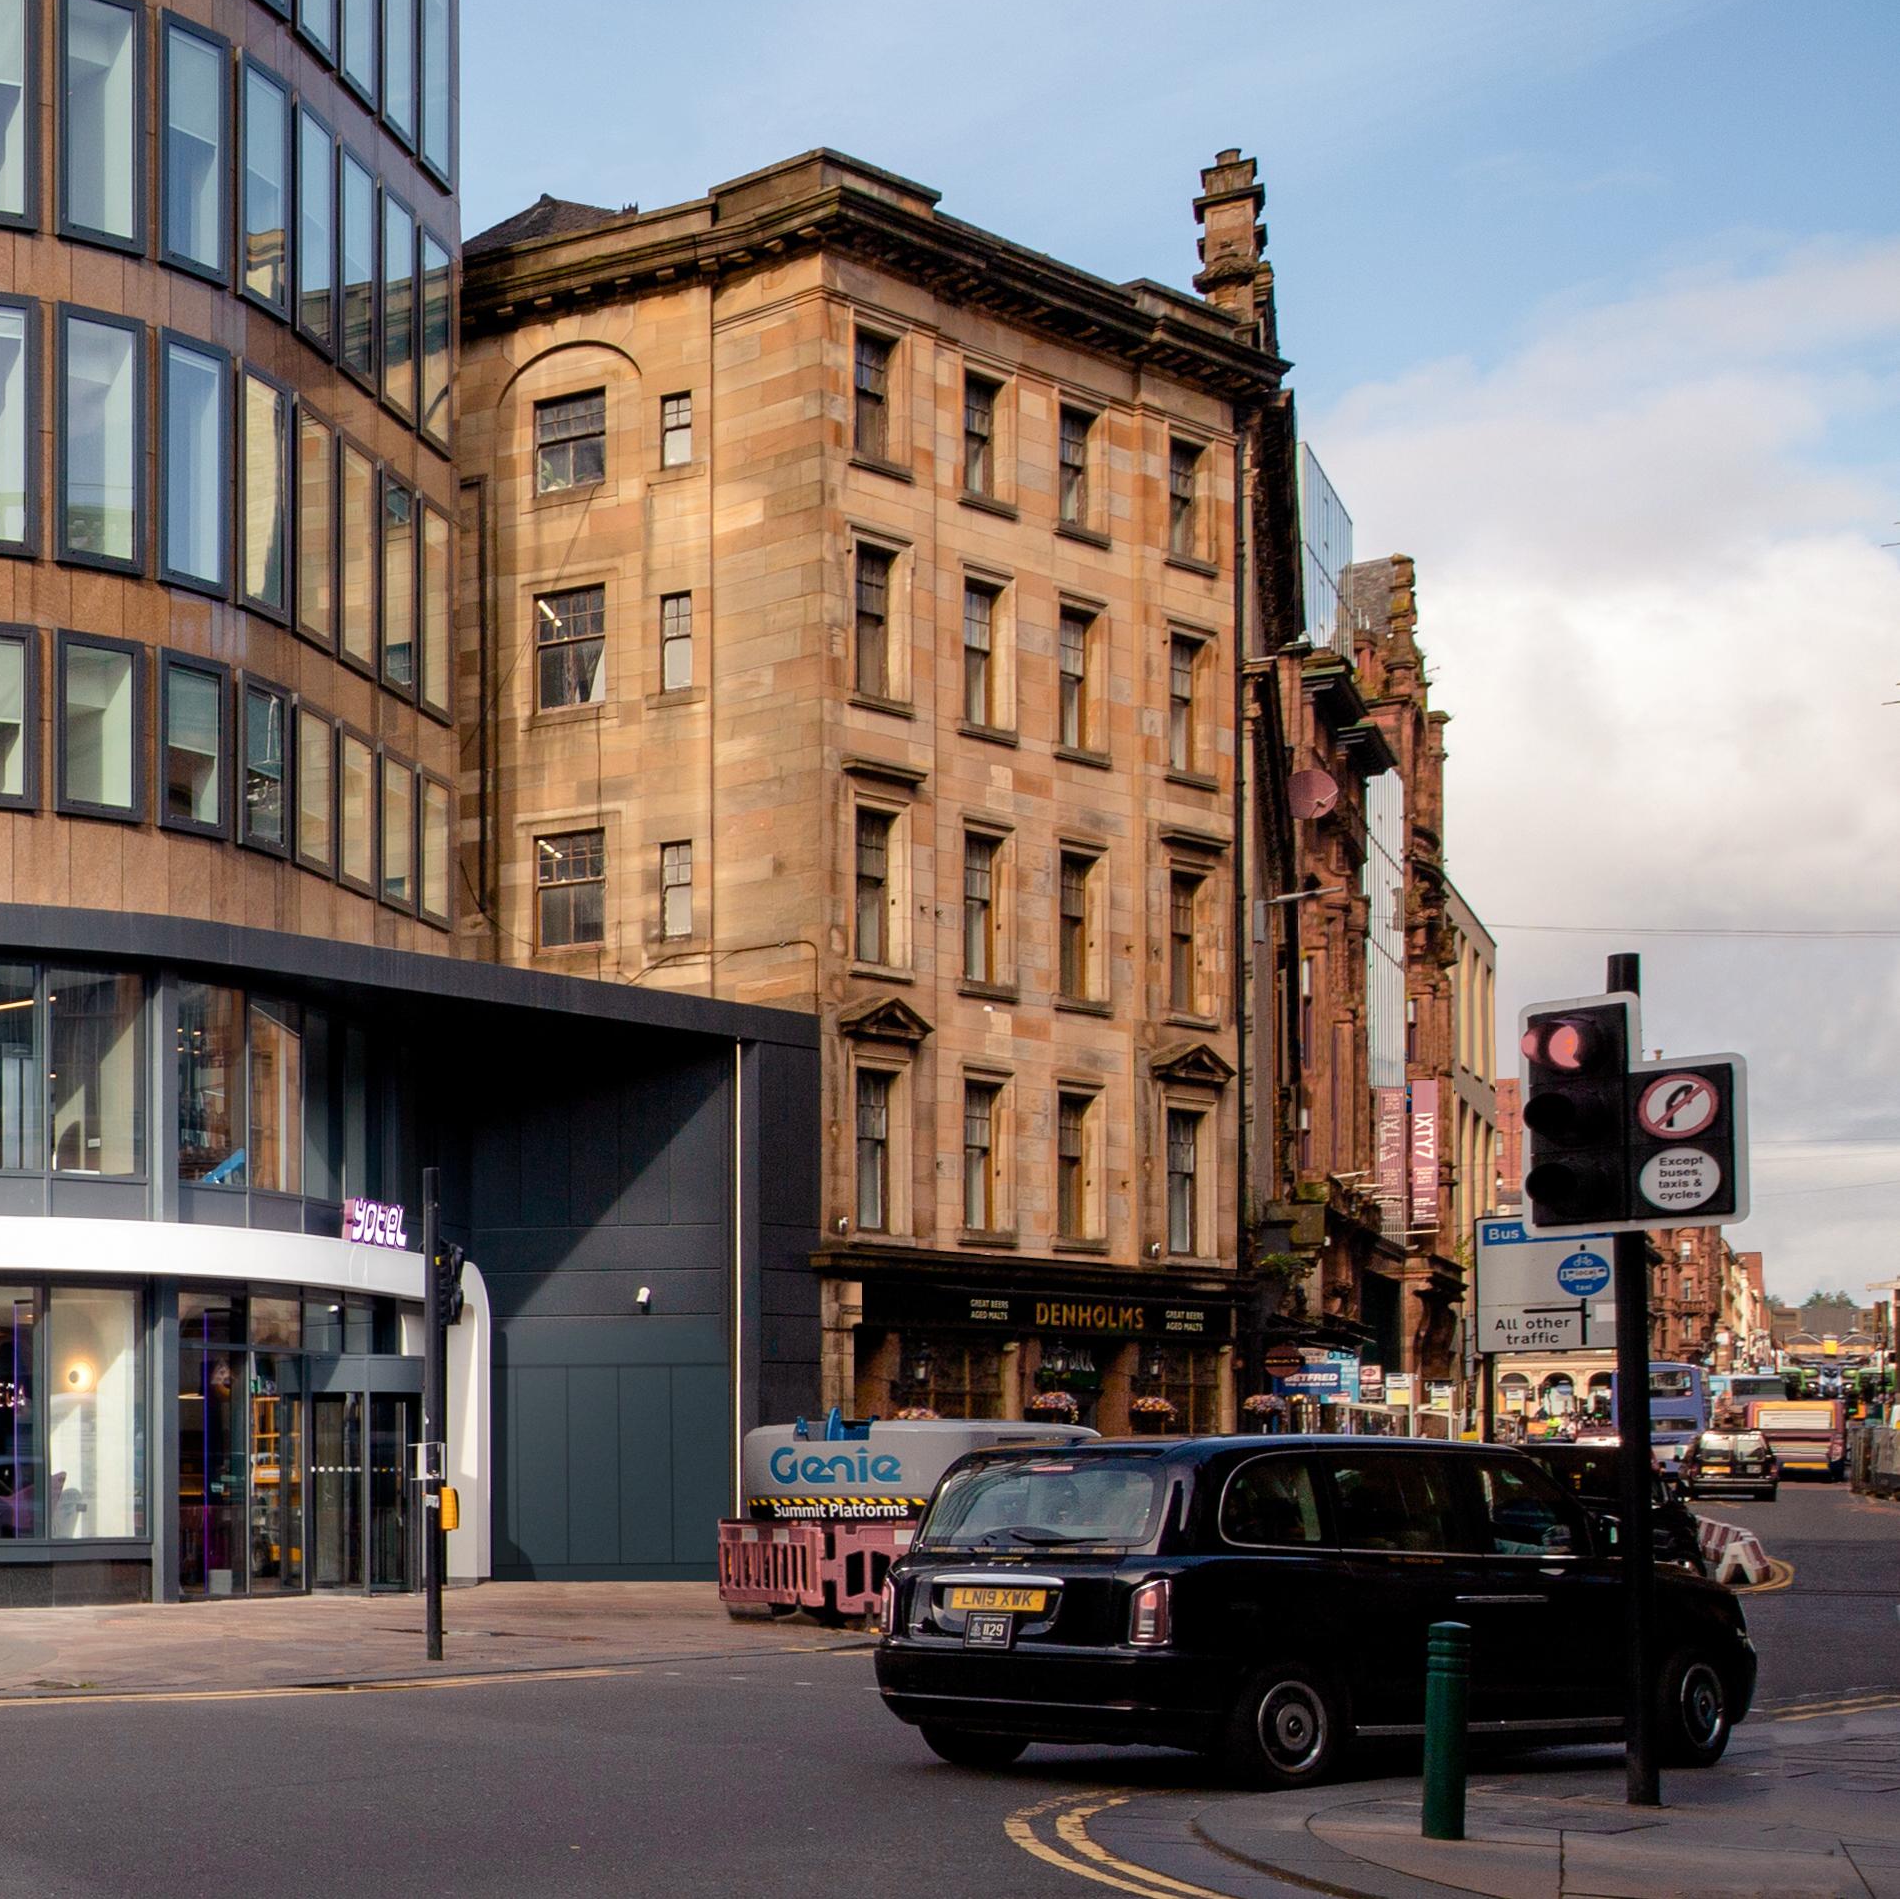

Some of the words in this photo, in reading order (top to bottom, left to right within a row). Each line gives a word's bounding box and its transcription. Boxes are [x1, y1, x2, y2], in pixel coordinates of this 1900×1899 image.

[1659, 1156, 1703, 1166] Except
[1659, 1168, 1703, 1177] buses,
[1658, 1179, 1690, 1188] taxis
[1693, 1178, 1703, 1187] &
[1659, 1190, 1702, 1201] cycles
[1488, 1228, 1520, 1240] Bus
[969, 1298, 989, 1309] GREAT
[989, 1299, 1009, 1310] BEERS
[970, 1310, 987, 1320] AGED
[987, 1310, 1008, 1321] MALTS
[1035, 1301, 1145, 1330] DENHOLMS
[1164, 1310, 1184, 1320] GREAT
[1184, 1310, 1204, 1321] BEERS
[1165, 1321, 1183, 1331] AGED
[1183, 1321, 1204, 1332] MALTS
[1494, 1318, 1517, 1331] All
[1525, 1317, 1571, 1330] other
[1505, 1331, 1560, 1345] traffic
[770, 1446, 902, 1485] Genie
[774, 1502, 826, 1518] Summit
[828, 1502, 909, 1518] Platforms
[961, 1589, 996, 1606] LN19
[1001, 1589, 1032, 1607] XWK
